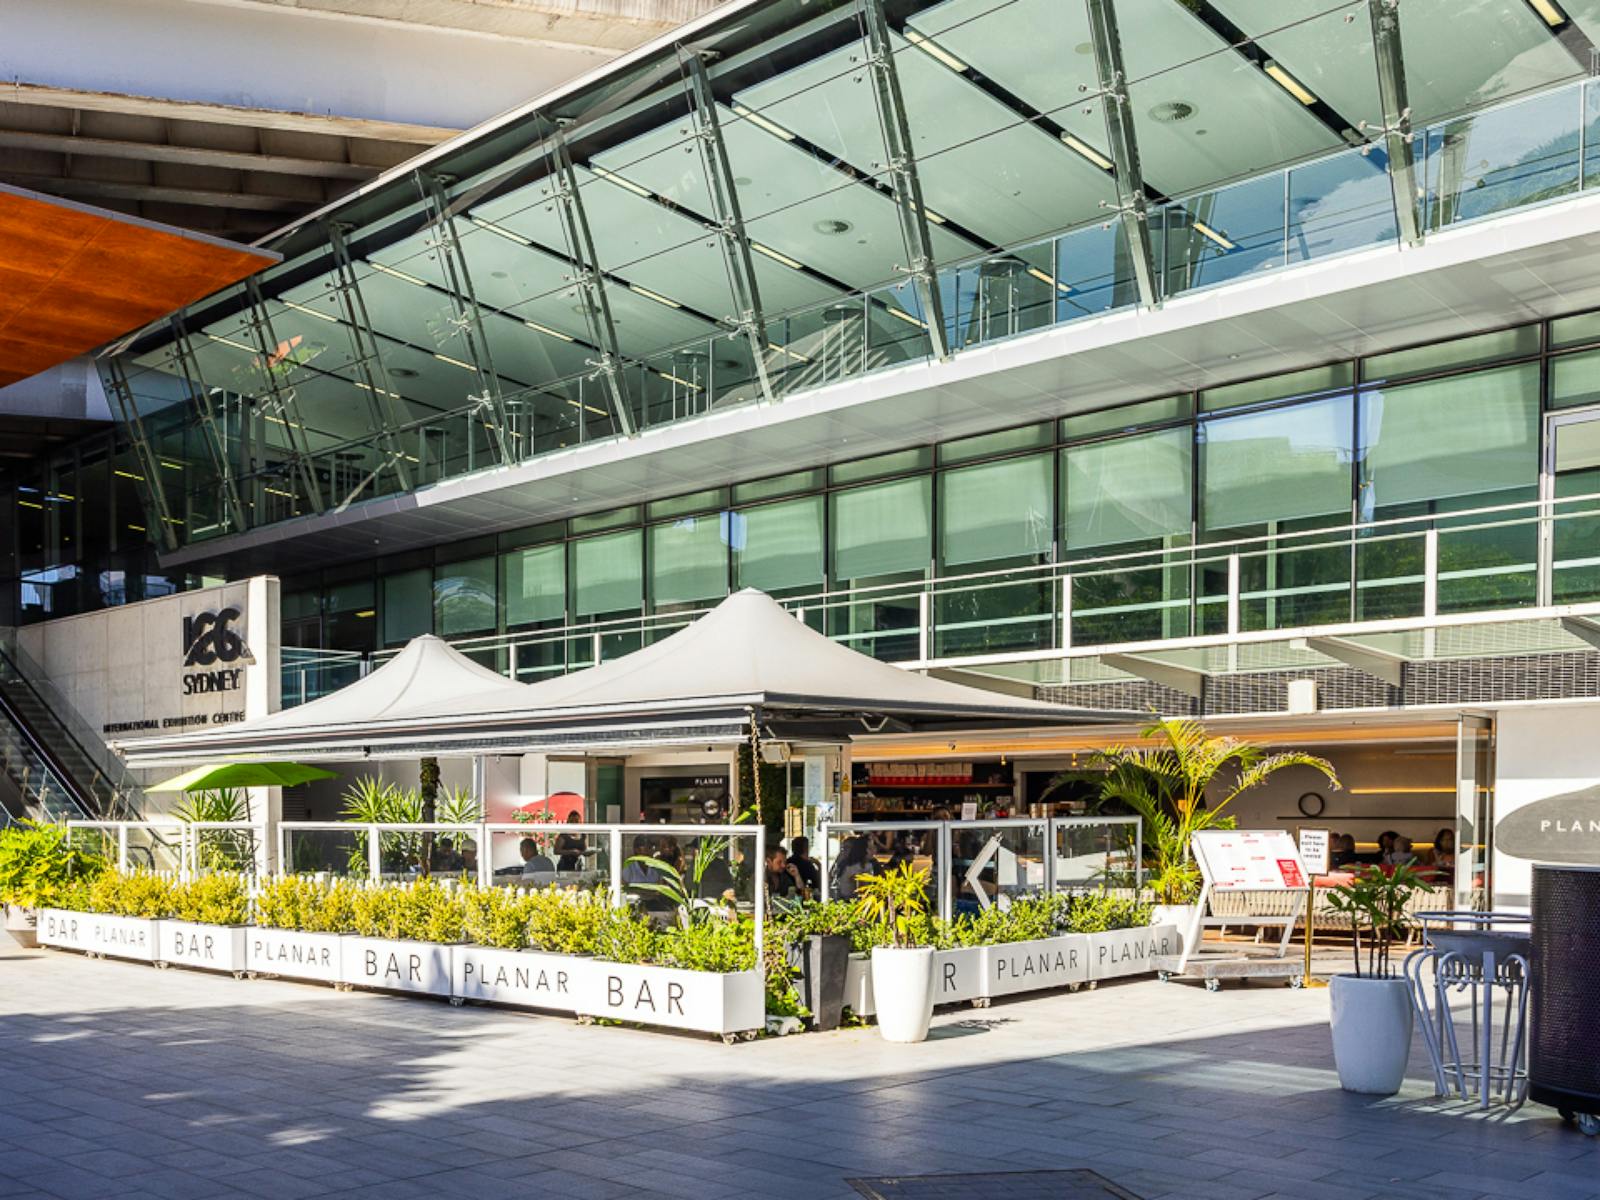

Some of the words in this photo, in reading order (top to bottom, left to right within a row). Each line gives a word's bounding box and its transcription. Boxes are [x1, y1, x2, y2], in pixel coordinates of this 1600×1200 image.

[183, 669, 242, 695] SYDNEY
[103, 719, 159, 733] INTERNATIONAL
[162, 714, 208, 728] EXHIBITION
[212, 710, 246, 724] CENTRE
[47, 917, 79, 941] BAR
[94, 925, 146, 947] PLANAR
[174, 931, 215, 960] BAR
[254, 940, 331, 967] PLANAR
[1099, 937, 1170, 965] PLANAR
[365, 949, 422, 982] BAR
[463, 962, 569, 994] PLANAR
[997, 949, 1079, 981] PLANAR
[607, 975, 685, 1016] BAR
